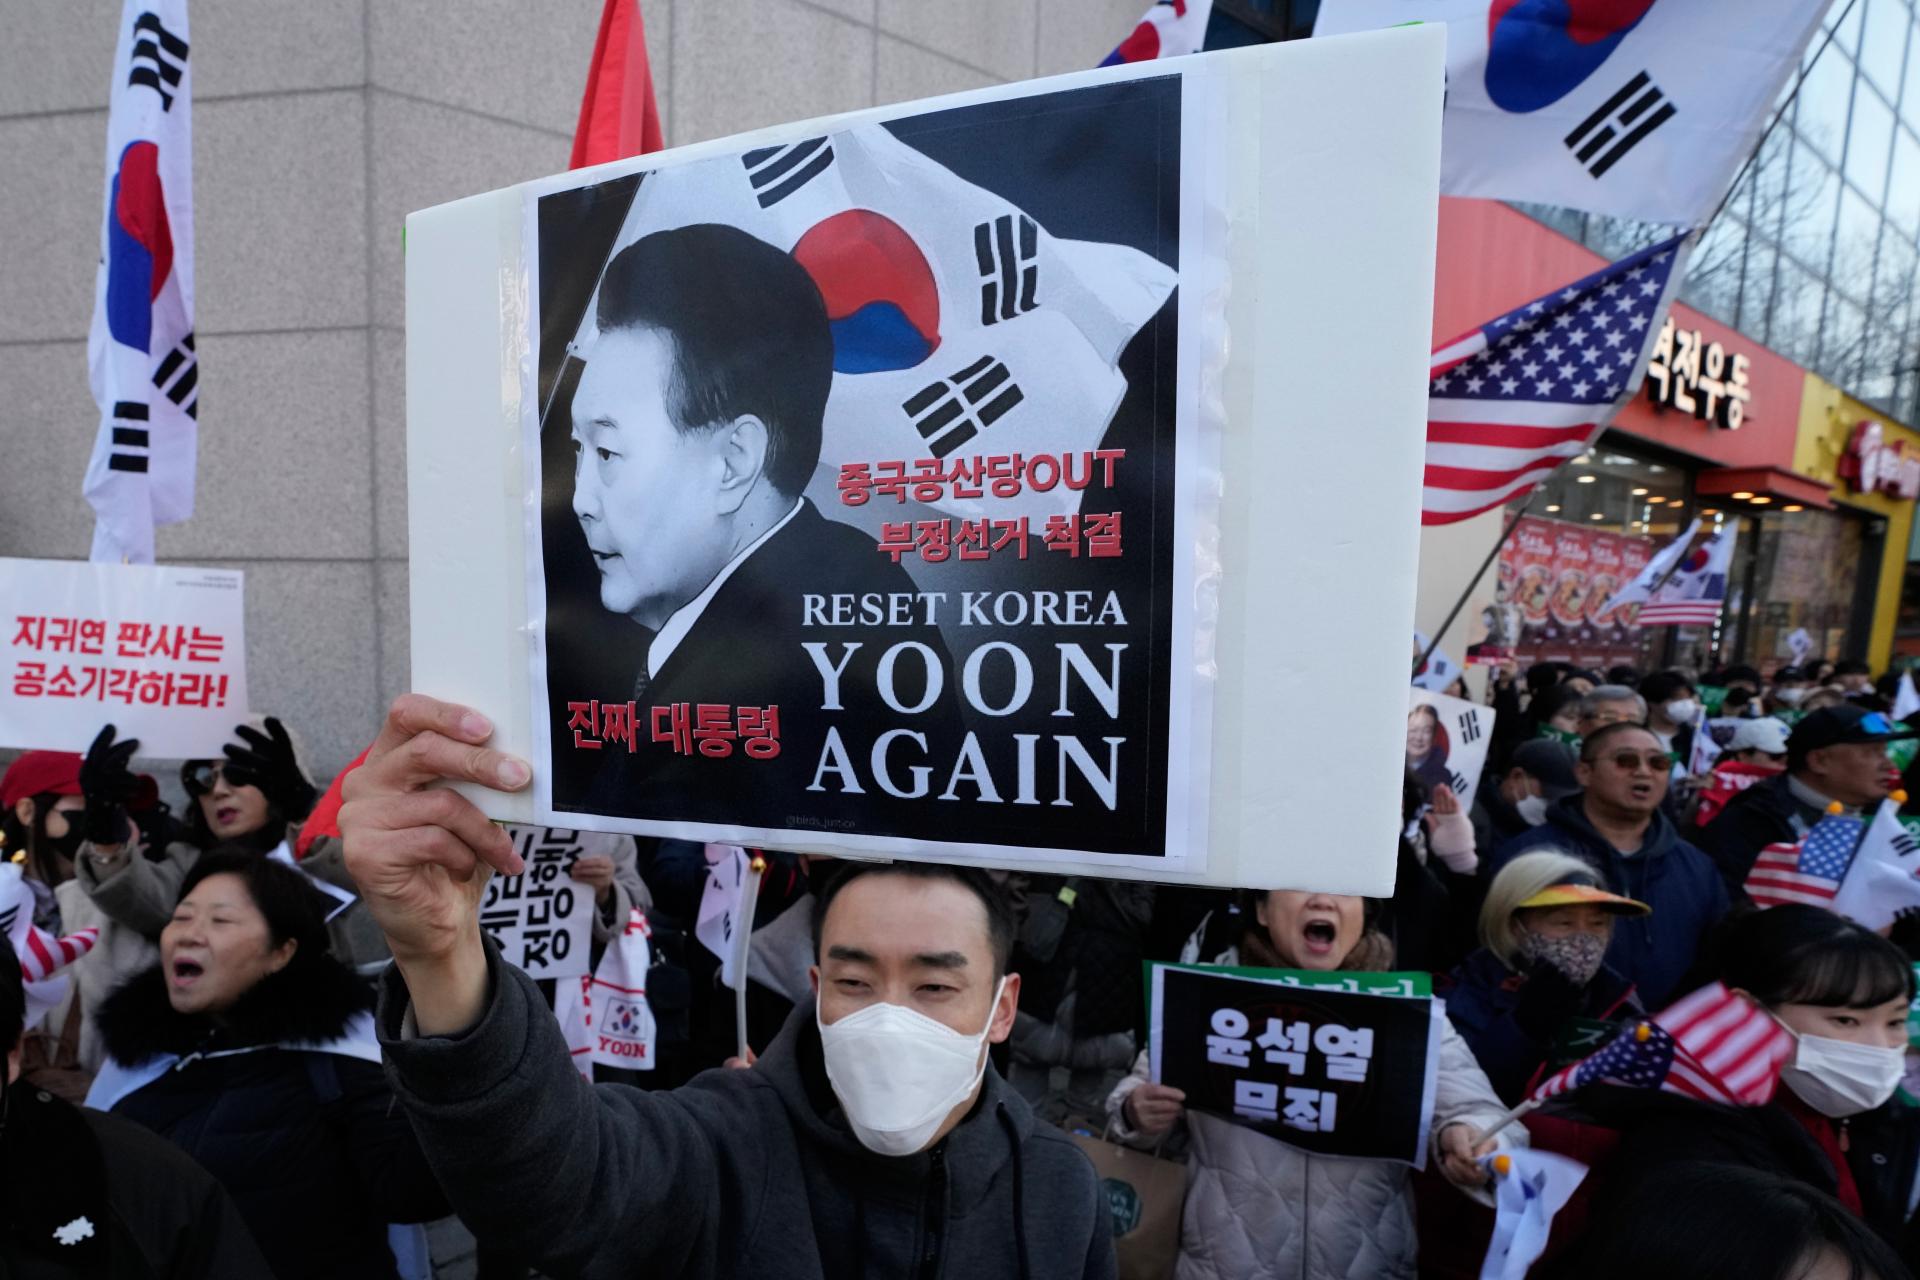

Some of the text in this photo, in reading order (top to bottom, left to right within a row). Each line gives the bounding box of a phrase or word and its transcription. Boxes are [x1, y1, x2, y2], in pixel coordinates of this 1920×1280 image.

[837, 449, 1126, 506] 중국공산당OUT
[877, 511, 1123, 563] 부정선거 척결
[802, 590, 1128, 626] RESET KOREA
[12, 616, 224, 662] 지귀연 판사는
[14, 661, 228, 708] 공소기각하라!
[801, 640, 1129, 719] YOON
[567, 699, 782, 760] 진짜 대통령
[805, 725, 1127, 811] AGAIN
[597, 1035, 647, 1058] YOON
[1206, 1008, 1374, 1083] 윤석열
